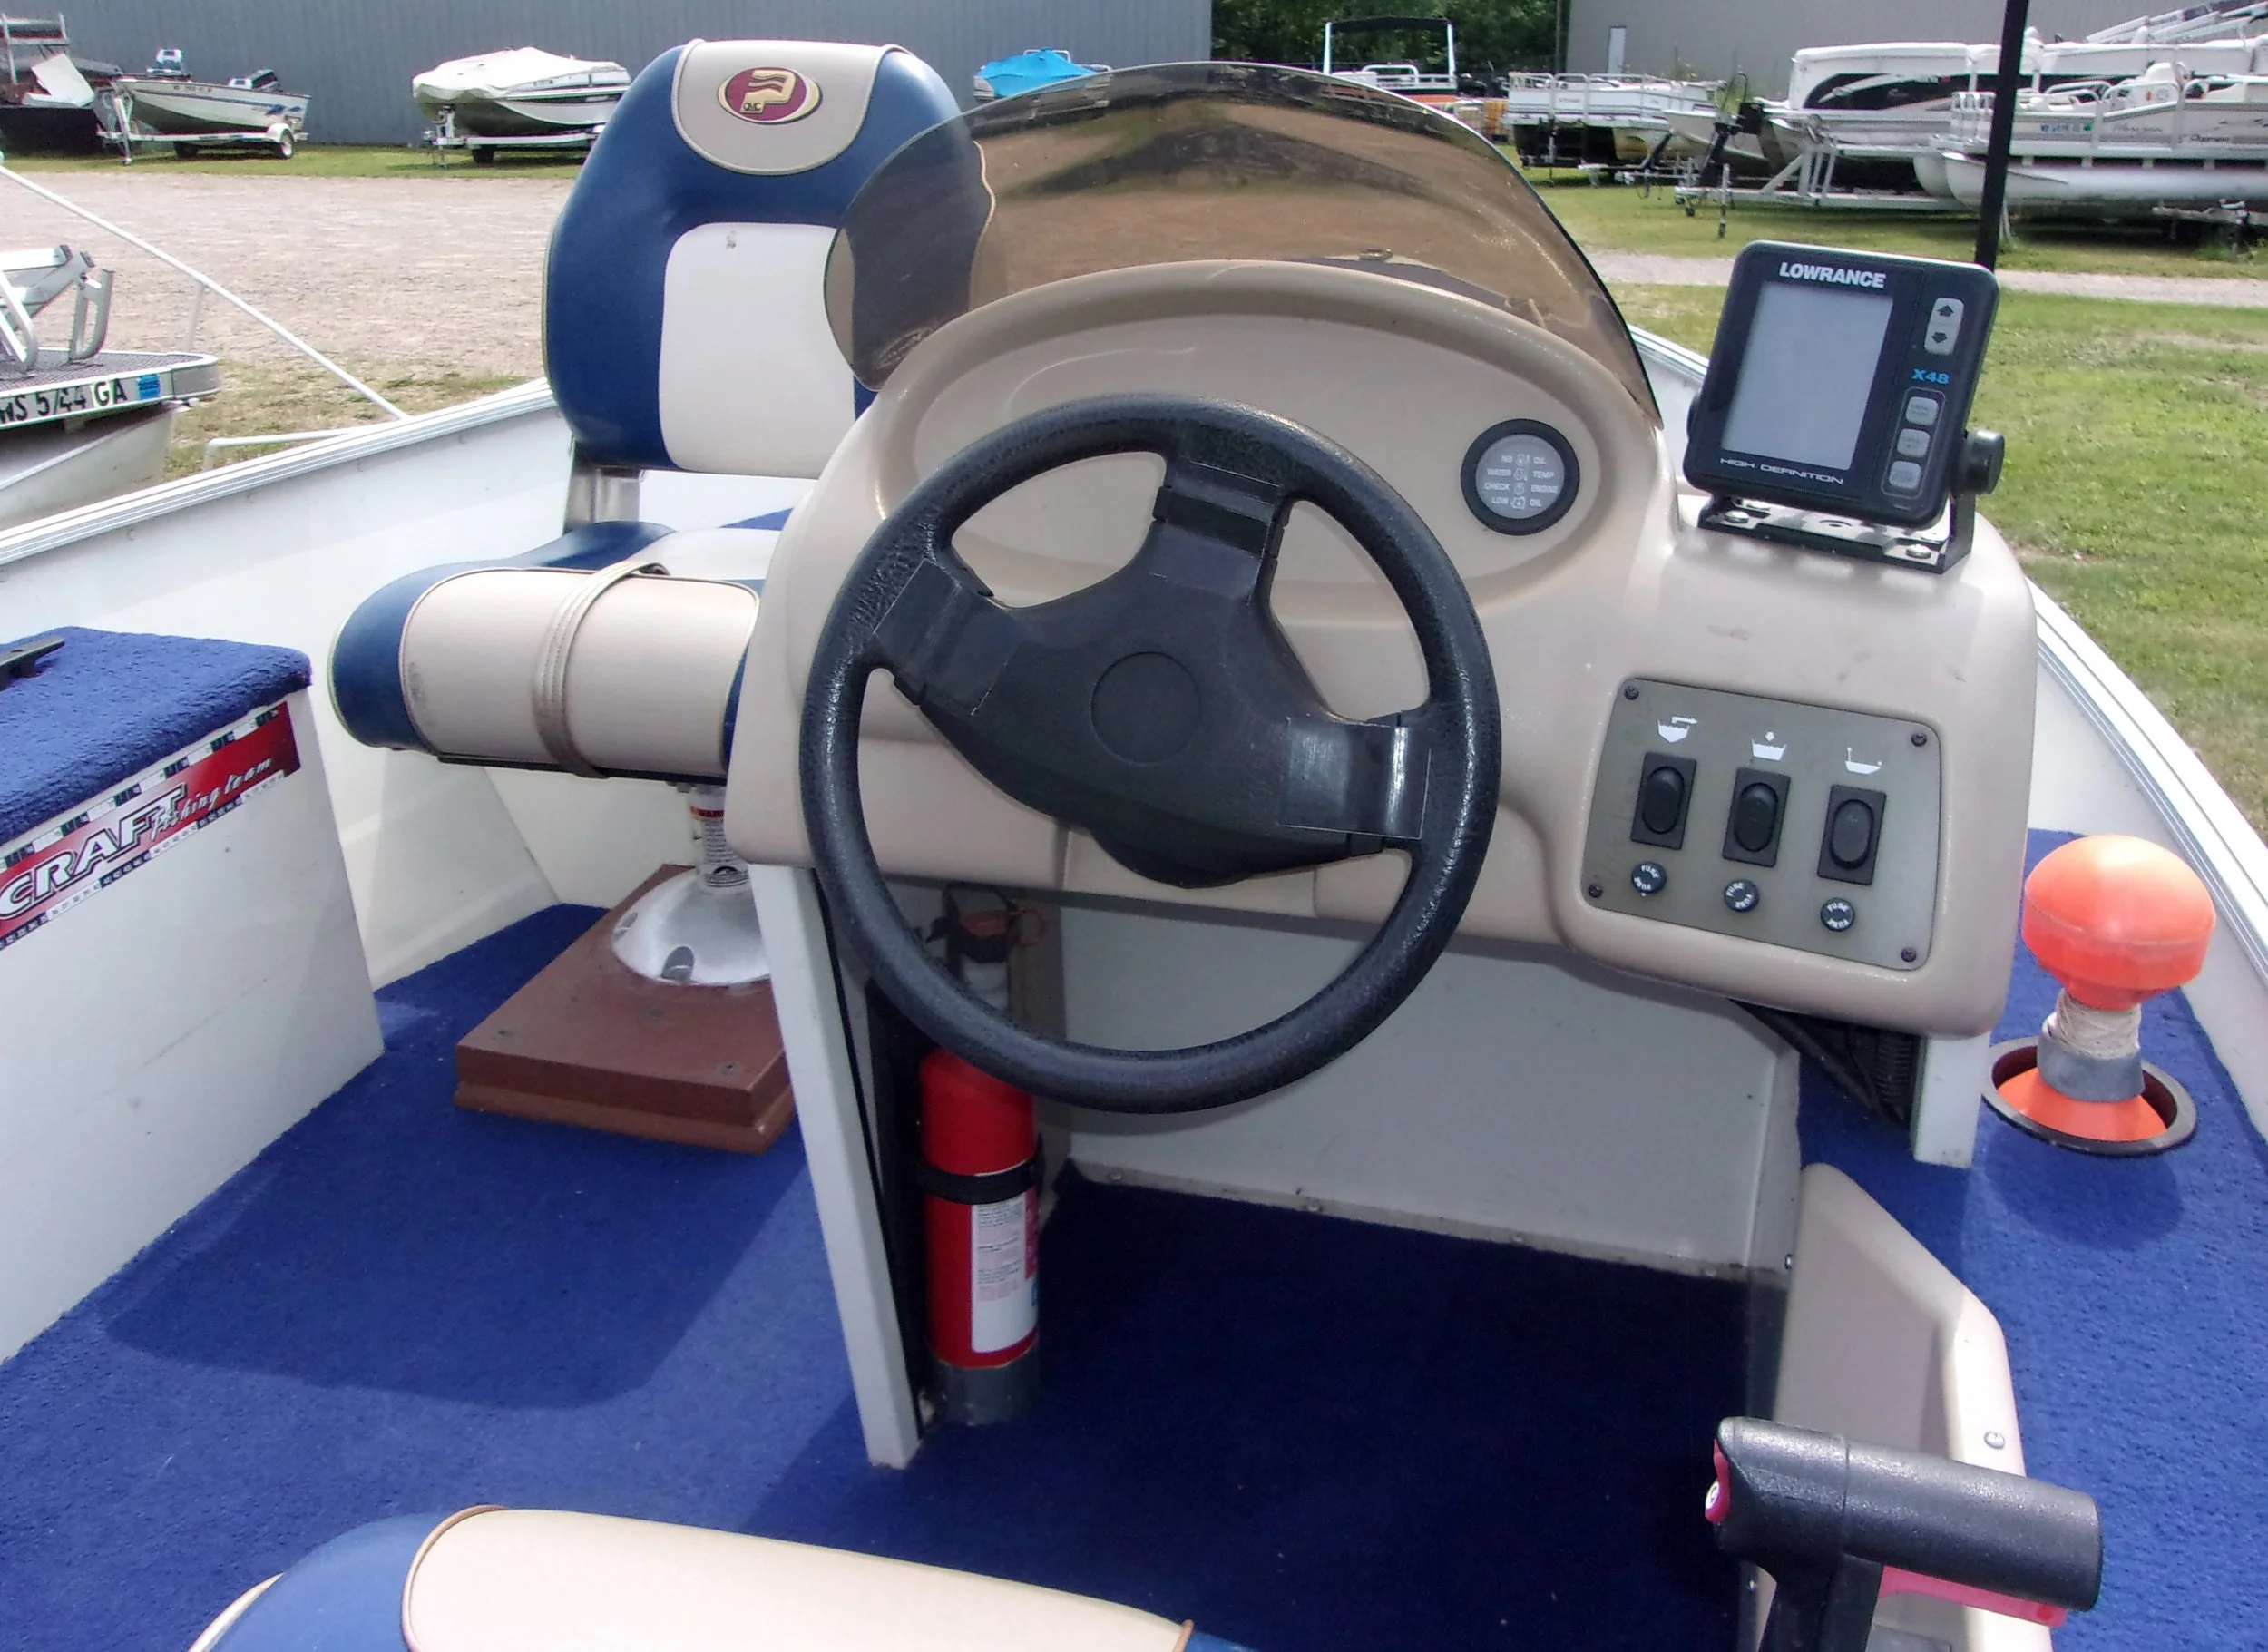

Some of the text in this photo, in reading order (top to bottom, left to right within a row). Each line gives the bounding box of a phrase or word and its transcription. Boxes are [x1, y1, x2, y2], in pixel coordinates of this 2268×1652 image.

[1779, 261, 1887, 289] LOWRANCE
[1911, 368, 1950, 385] X48
[94, 377, 128, 406] GA
[1486, 468, 1555, 478] WATER TEMP
[1720, 457, 1844, 485] HIGH DEFINITION
[1484, 482, 1559, 494] CHECK ENGINE
[1530, 498, 1542, 507] OIL
[0, 783, 188, 920] CRAFT
[1641, 865, 1659, 879] FUSE
[1725, 882, 1744, 897] FUSE
[1826, 902, 1849, 913] FUSE
